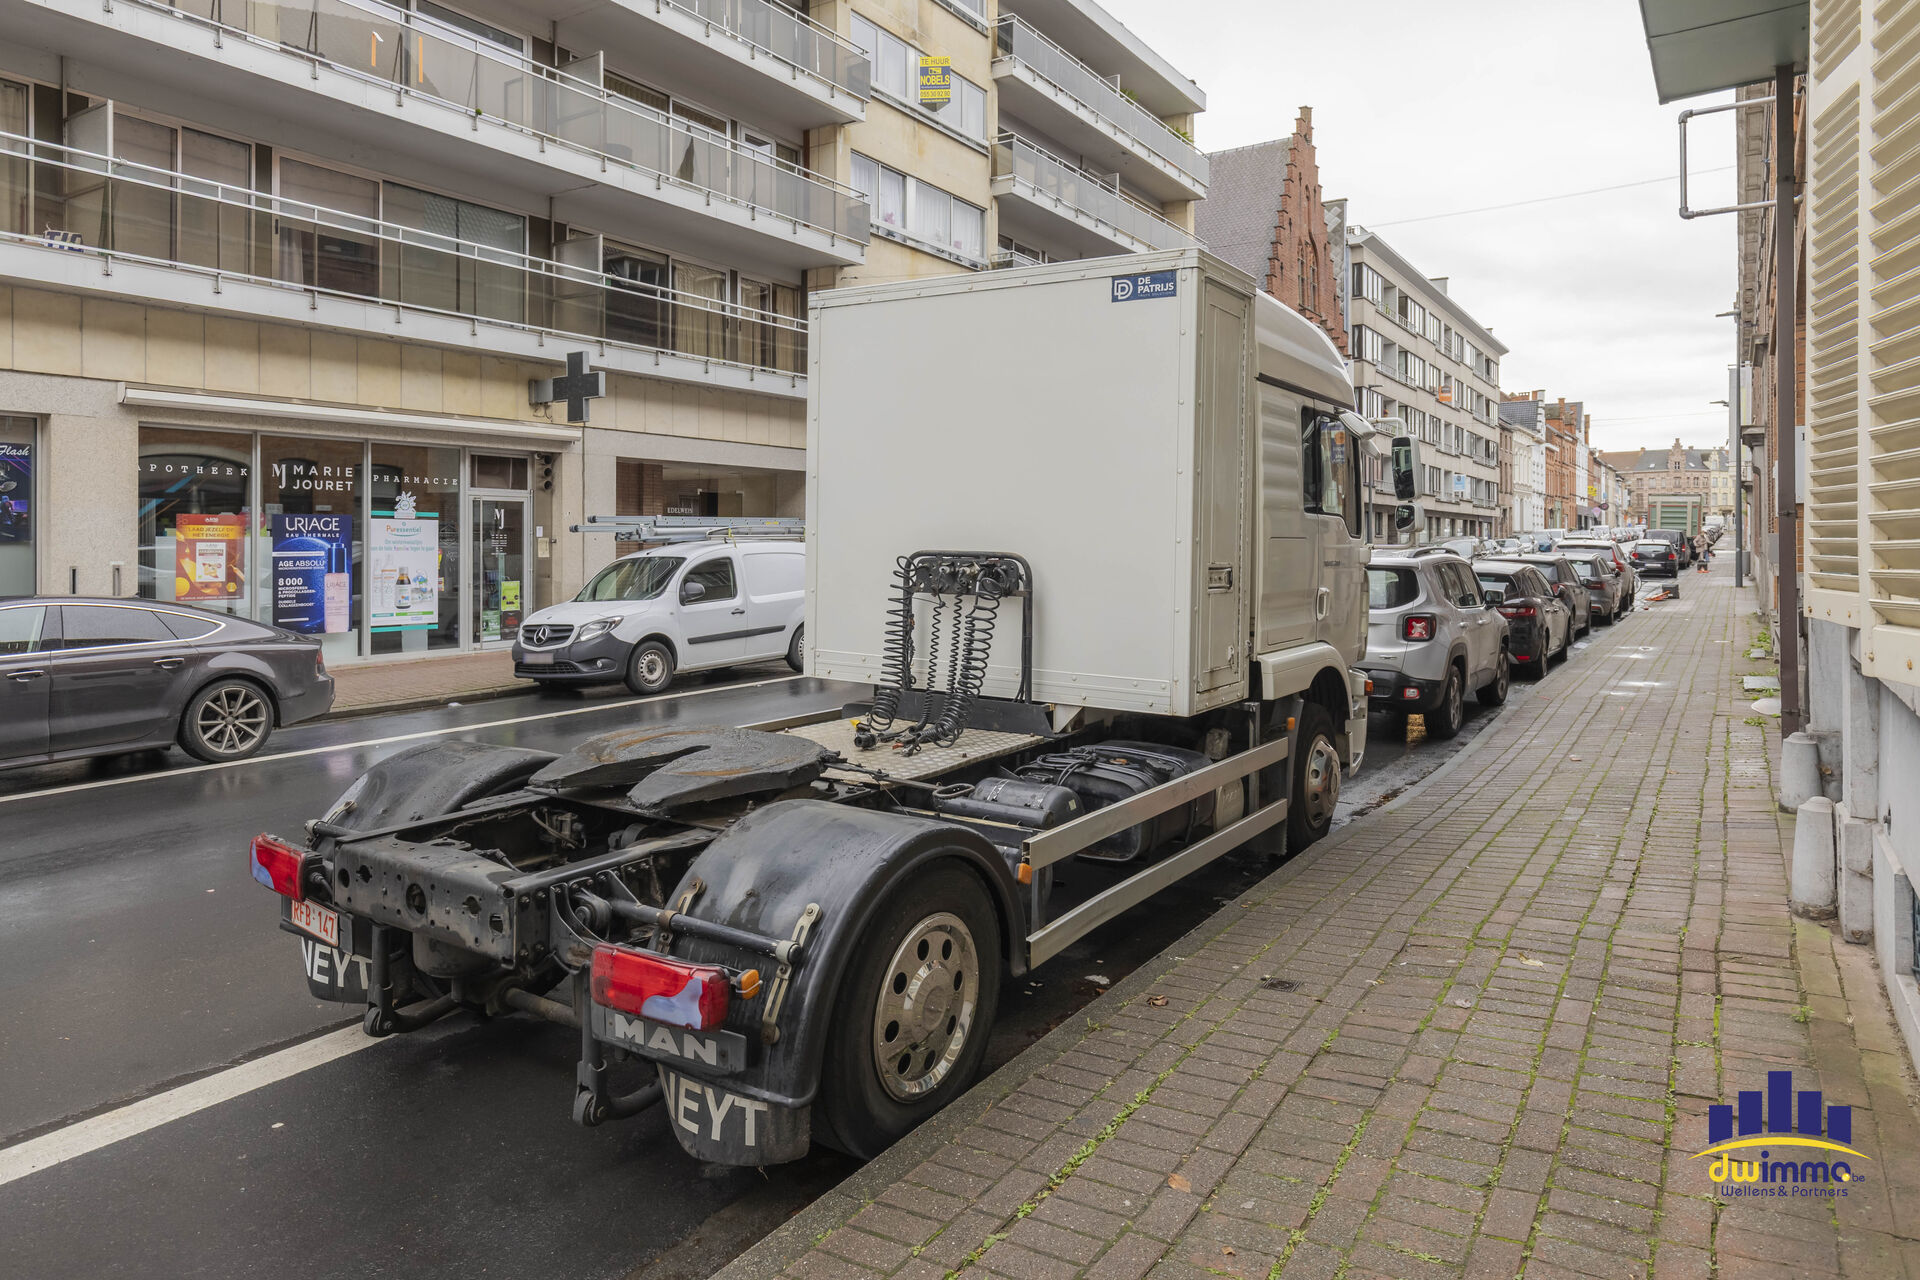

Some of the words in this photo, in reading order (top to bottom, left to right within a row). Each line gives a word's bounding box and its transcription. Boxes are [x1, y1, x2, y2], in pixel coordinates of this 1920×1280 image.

[920, 75, 950, 86] NOBELS
[1137, 276, 1151, 285] DE
[1137, 282, 1174, 294] PATRIJS
[293, 464, 353, 477] MARIE
[293, 480, 353, 491] JOURET
[373, 475, 458, 485] PHARMACIE
[285, 517, 340, 533] URIAGE
[295, 559, 325, 567] ABSOLU
[615, 1013, 717, 1066] MAN
